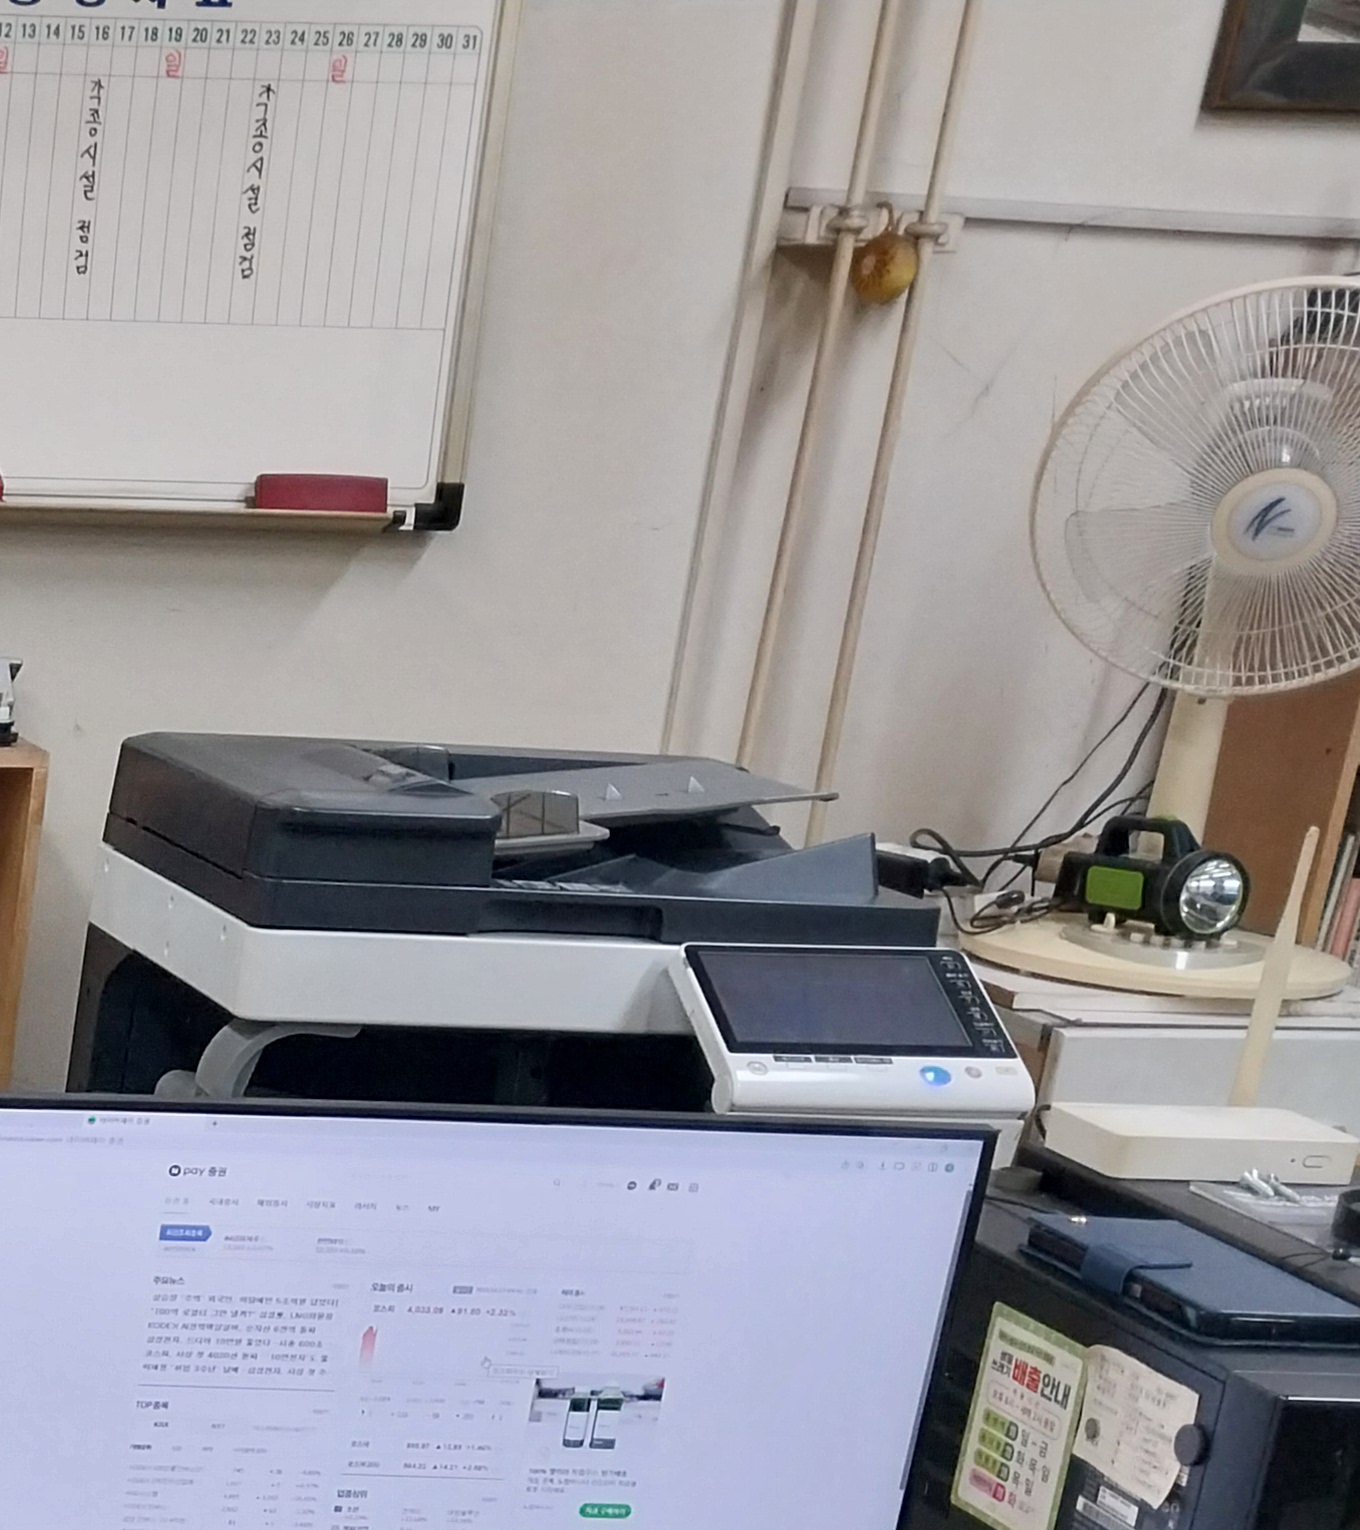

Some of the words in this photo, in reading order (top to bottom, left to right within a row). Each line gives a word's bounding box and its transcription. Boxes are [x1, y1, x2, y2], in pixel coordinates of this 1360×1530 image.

[21, 24, 36, 39] 13
[46, 24, 61, 40] 14
[70, 25, 85, 40] 15
[95, 25, 110, 41] 16
[120, 26, 135, 41] 17
[144, 27, 159, 42] 18
[168, 27, 183, 43] 19
[192, 27, 208, 43] 20
[215, 28, 231, 44] 21
[240, 29, 257, 45] 22
[264, 30, 281, 45] 23
[290, 30, 305, 46] 24
[313, 31, 329, 46] 25
[338, 31, 354, 47] 26
[363, 32, 380, 48] 27
[387, 32, 403, 48] 28
[411, 33, 428, 48] 29
[436, 33, 454, 49] 30
[462, 34, 477, 49] 31
[164, 48, 182, 79] 일
[331, 54, 348, 84] 일
[1012, 1357, 1042, 1394] 배출
[1040, 1373, 1072, 1411] 안내
